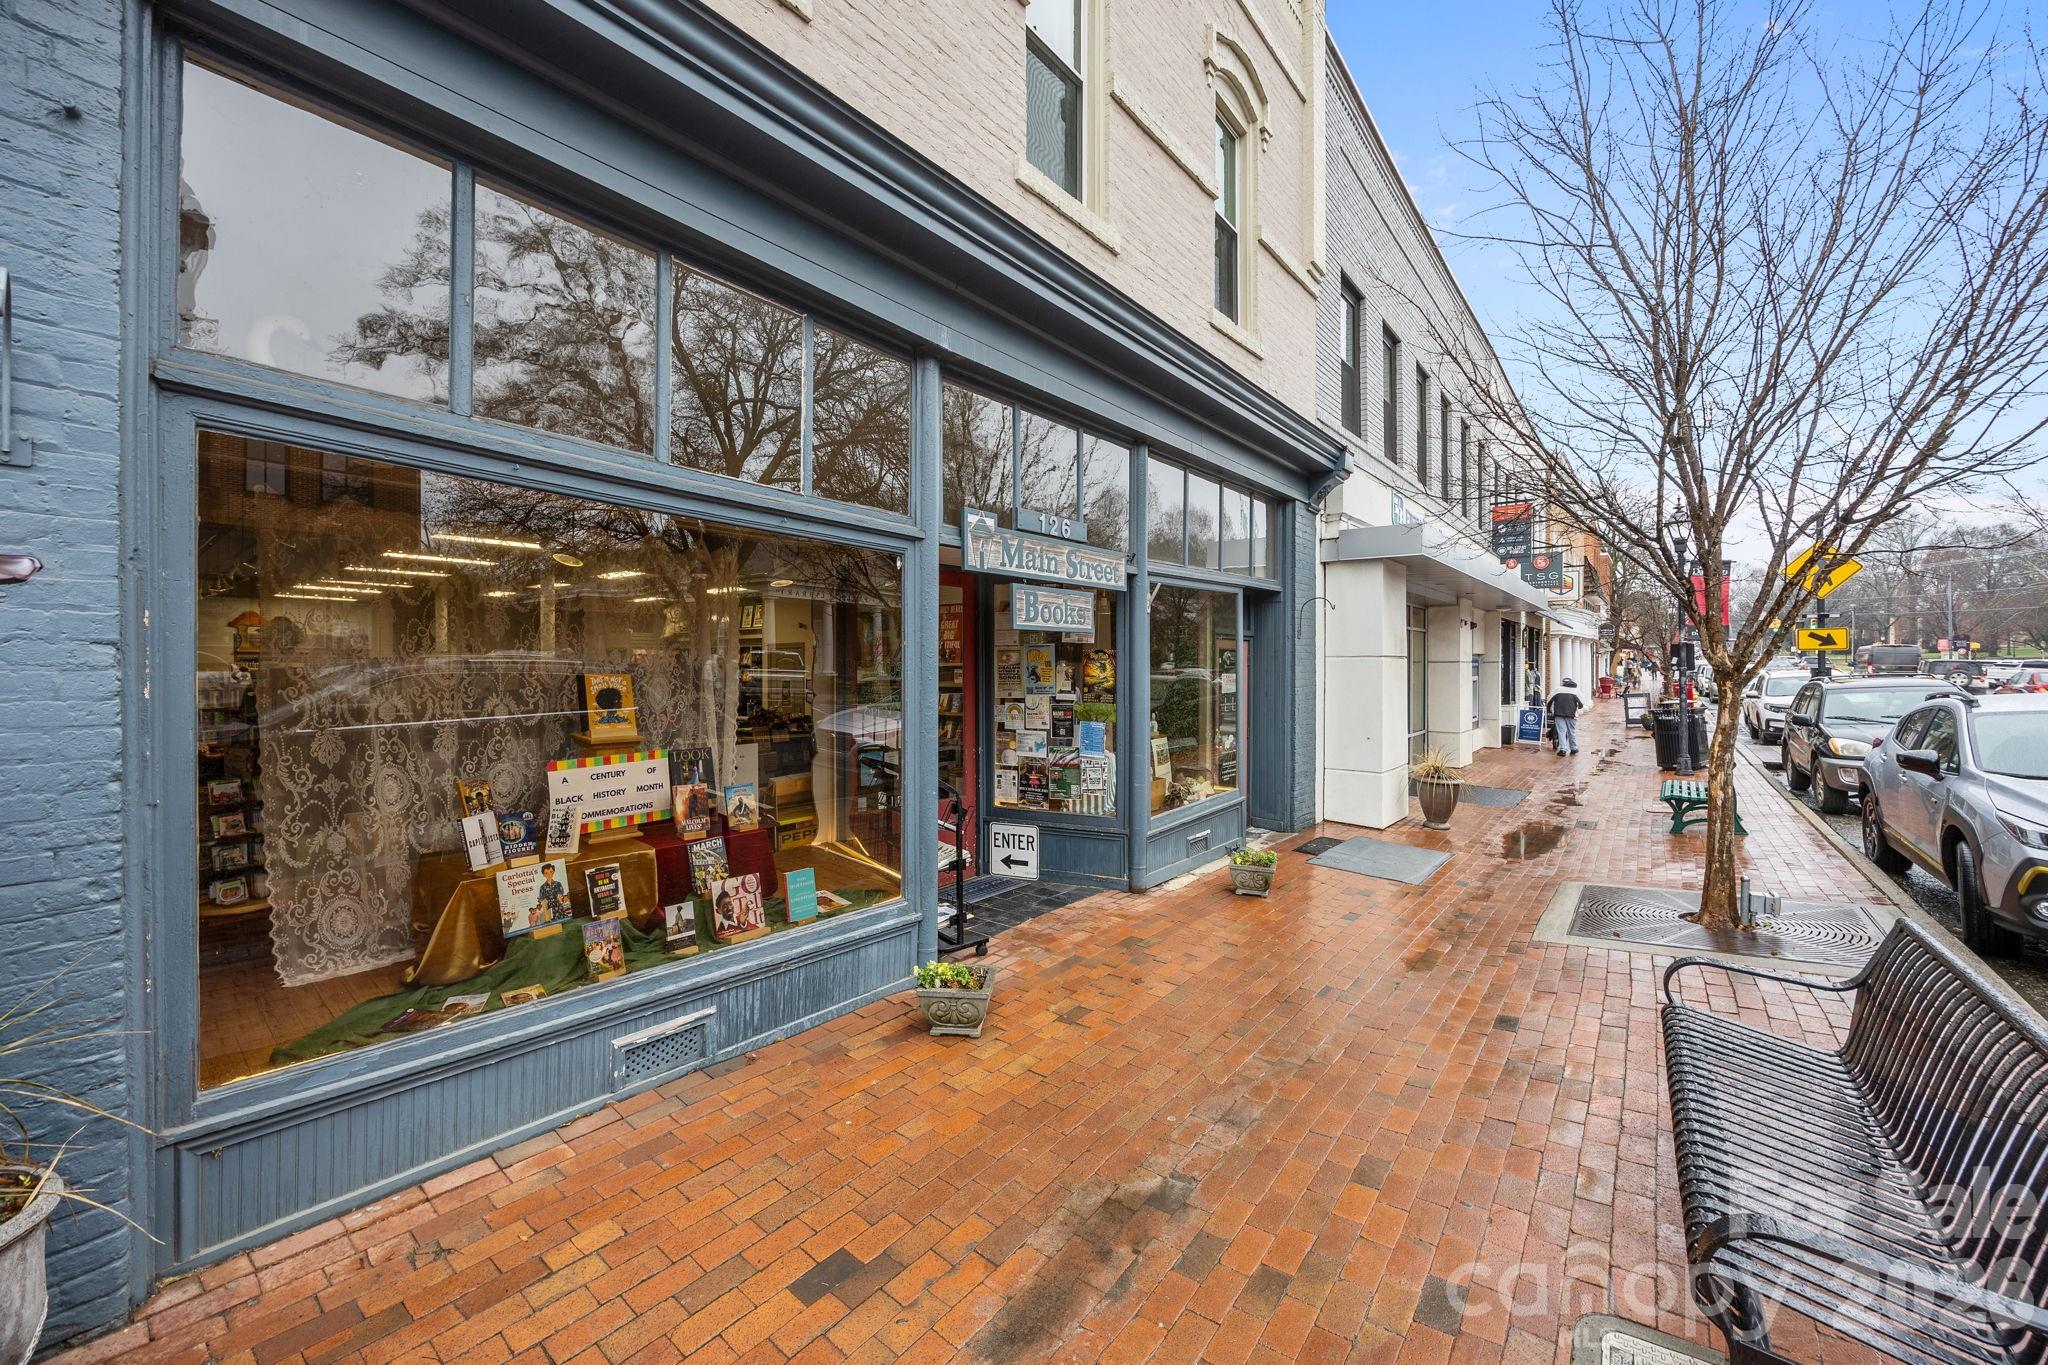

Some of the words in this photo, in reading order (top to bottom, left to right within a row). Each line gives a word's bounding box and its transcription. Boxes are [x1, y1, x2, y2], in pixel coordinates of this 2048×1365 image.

[1039, 513, 1071, 538] 126
[1000, 536, 1059, 575] Main
[1065, 548, 1120, 583] Street
[1023, 590, 1086, 625] Books
[673, 749, 711, 762] LOOK
[590, 770, 626, 780] CENTURY
[555, 795, 584, 805] BLACK
[593, 788, 627, 799] HISTORY
[636, 783, 664, 792] MONTH
[581, 802, 654, 819] OMMEMORATIONS
[693, 838, 722, 851] MARCH
[994, 832, 1035, 851] ENTER
[502, 868, 539, 882] Carlotta's
[507, 877, 536, 889] Special
[511, 886, 534, 896] Dress
[721, 873, 761, 896] GO
